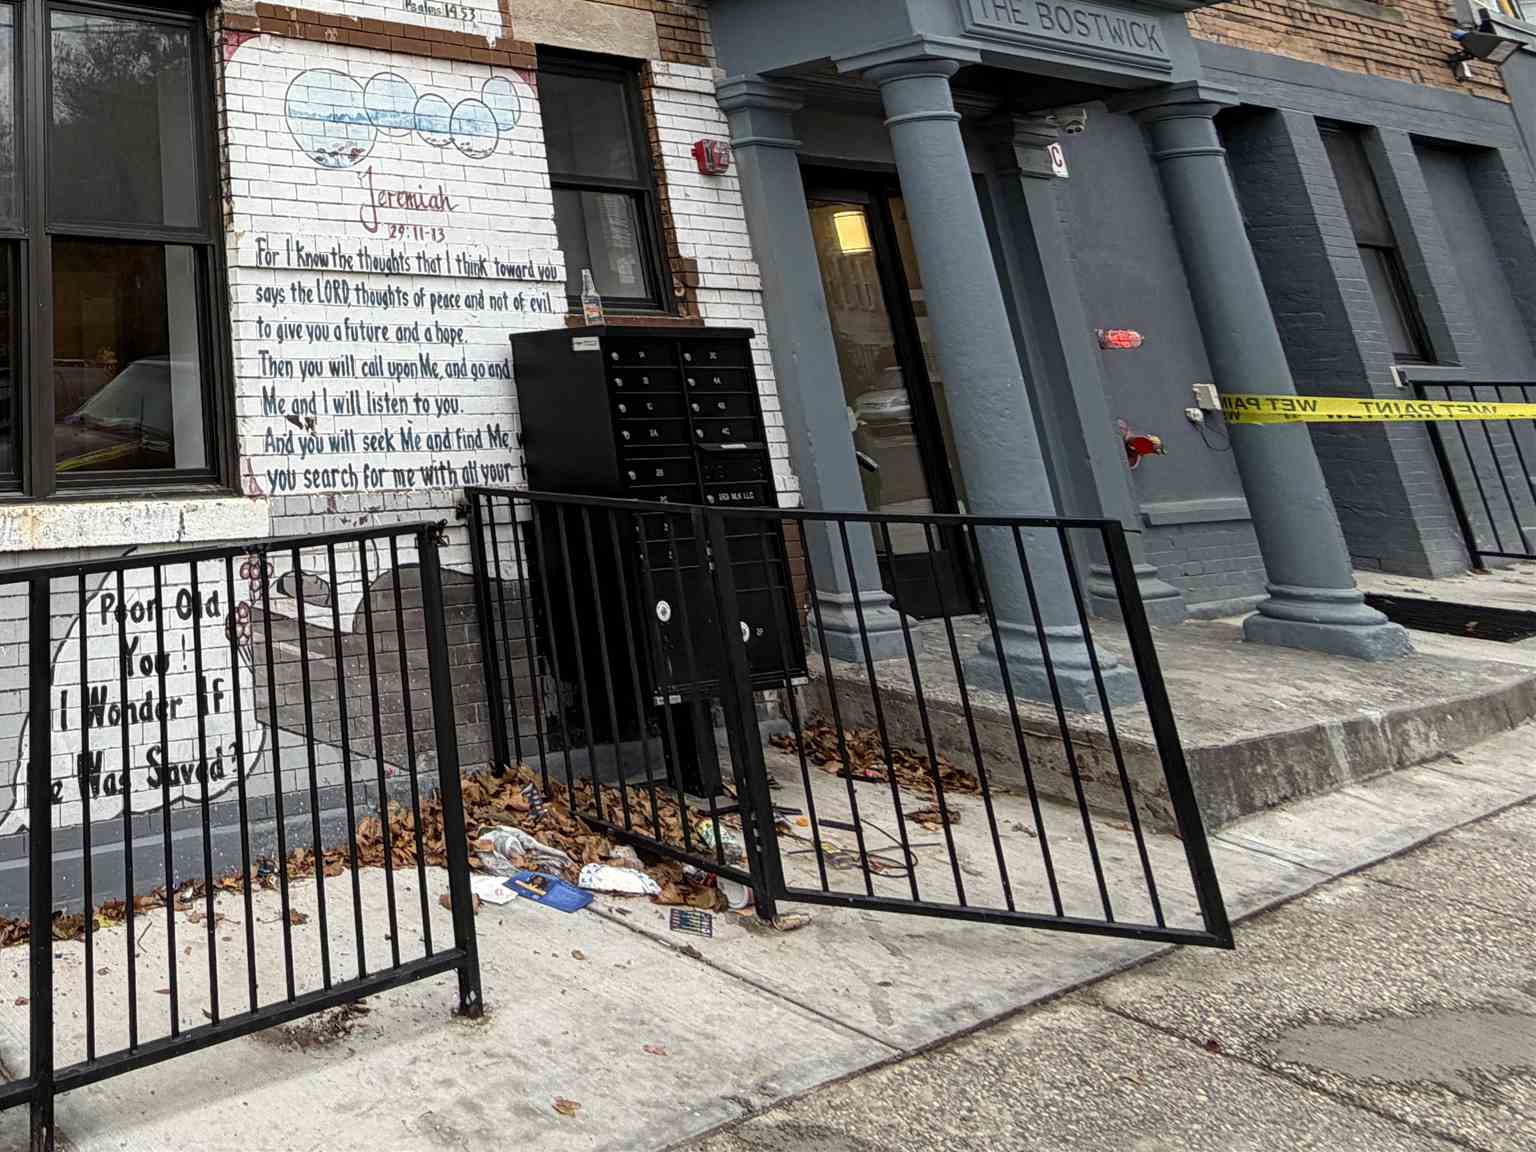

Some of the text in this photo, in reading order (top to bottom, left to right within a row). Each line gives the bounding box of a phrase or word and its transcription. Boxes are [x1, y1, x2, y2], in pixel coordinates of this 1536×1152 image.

[1035, 1, 1163, 53] BOSTWICK
[360, 165, 459, 233] Jeremiah
[389, 224, 445, 243] 29:11-13
[256, 237, 279, 267] For
[286, 239, 291, 265] I
[331, 243, 353, 271] the
[357, 246, 411, 274] thoughts
[416, 250, 444, 275] that
[446, 251, 451, 273] I
[495, 258, 534, 279] toward
[537, 263, 557, 282] you
[256, 279, 525, 314] says the LORD, thoughts of peace and not of
[256, 316, 468, 347] to give you a future and a hope.
[258, 350, 510, 383] Then you will call upon Me, and go and
[262, 386, 464, 418] Me and I will listen to you.
[264, 427, 294, 454] And
[298, 434, 324, 459] you
[328, 428, 356, 452] will
[362, 429, 395, 453] seek
[399, 427, 422, 453] Me
[426, 427, 451, 452] and
[486, 423, 513, 452] Me,
[268, 466, 296, 494] you
[304, 463, 359, 491] search
[363, 464, 384, 489] for
[392, 468, 415, 488] me
[420, 458, 459, 488] with
[462, 460, 479, 484] all
[479, 462, 511, 485] your
[61, 690, 68, 732] I
